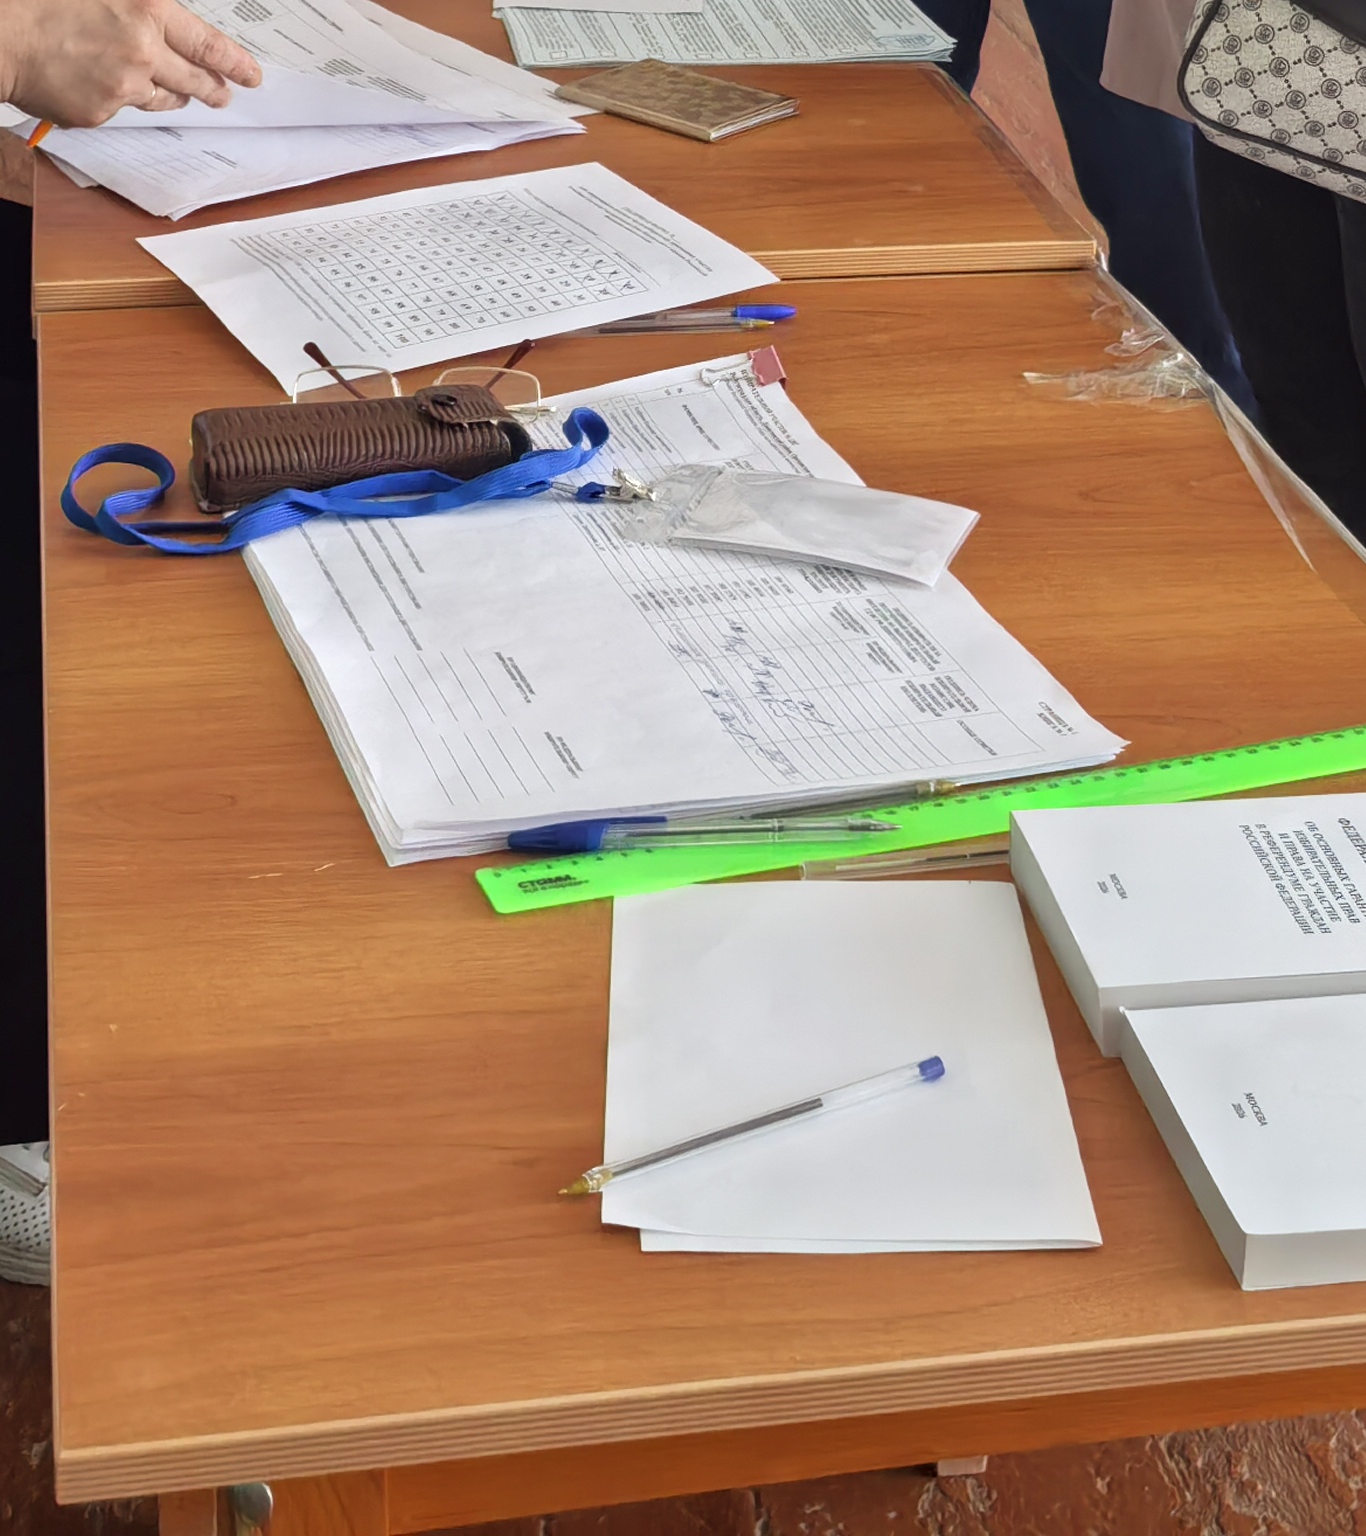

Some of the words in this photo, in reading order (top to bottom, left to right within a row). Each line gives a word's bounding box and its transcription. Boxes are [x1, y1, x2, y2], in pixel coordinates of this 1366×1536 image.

[1238, 823, 1282, 882] РОССИЙСКОЙ
[1275, 882, 1316, 935] ФЕДЕРАЦИИ
[1260, 829, 1305, 893] РЕФЕРЕНДУМЕ
[1297, 890, 1333, 935] ГРАЖДАН
[1283, 839, 1304, 867] ПРАВА
[1299, 868, 1315, 882] НА
[1308, 881, 1342, 923] УЧАСТИЕ
[1292, 829, 1345, 901] ИЗБИРАТЕЛЬНЫХ
[1338, 897, 1361, 924] ПРАВ
[1312, 831, 1351, 882] ОСНОВНЫХ
